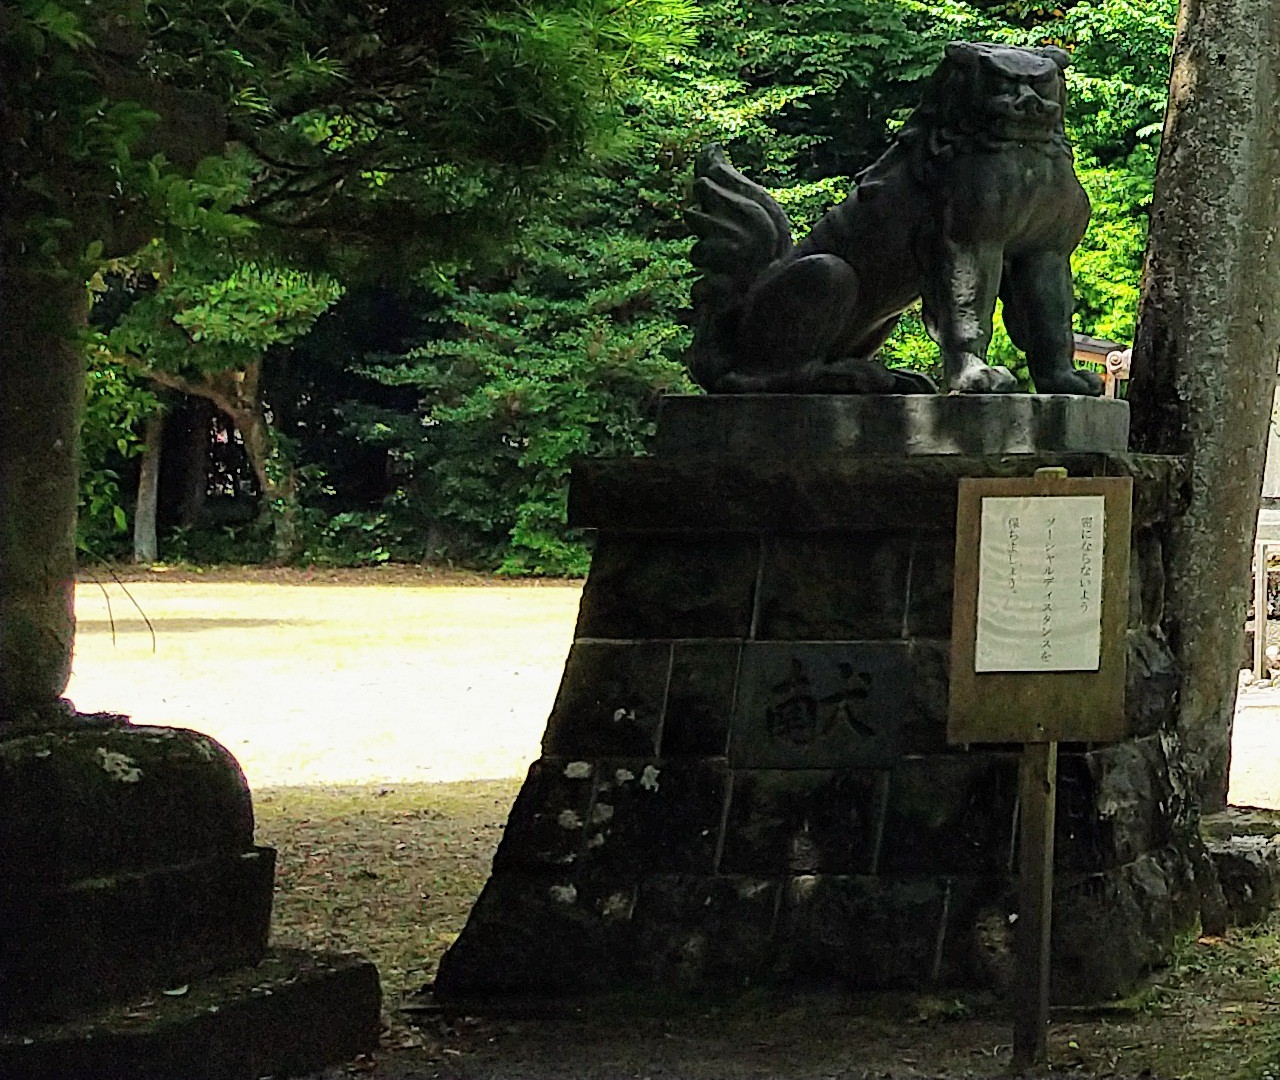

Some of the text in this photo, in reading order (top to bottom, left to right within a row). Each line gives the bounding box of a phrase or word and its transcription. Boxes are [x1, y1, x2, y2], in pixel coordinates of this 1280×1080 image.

[1040, 516, 1056, 664] ソーシャルディスタンスを
[1079, 516, 1093, 613] 密にならないよう
